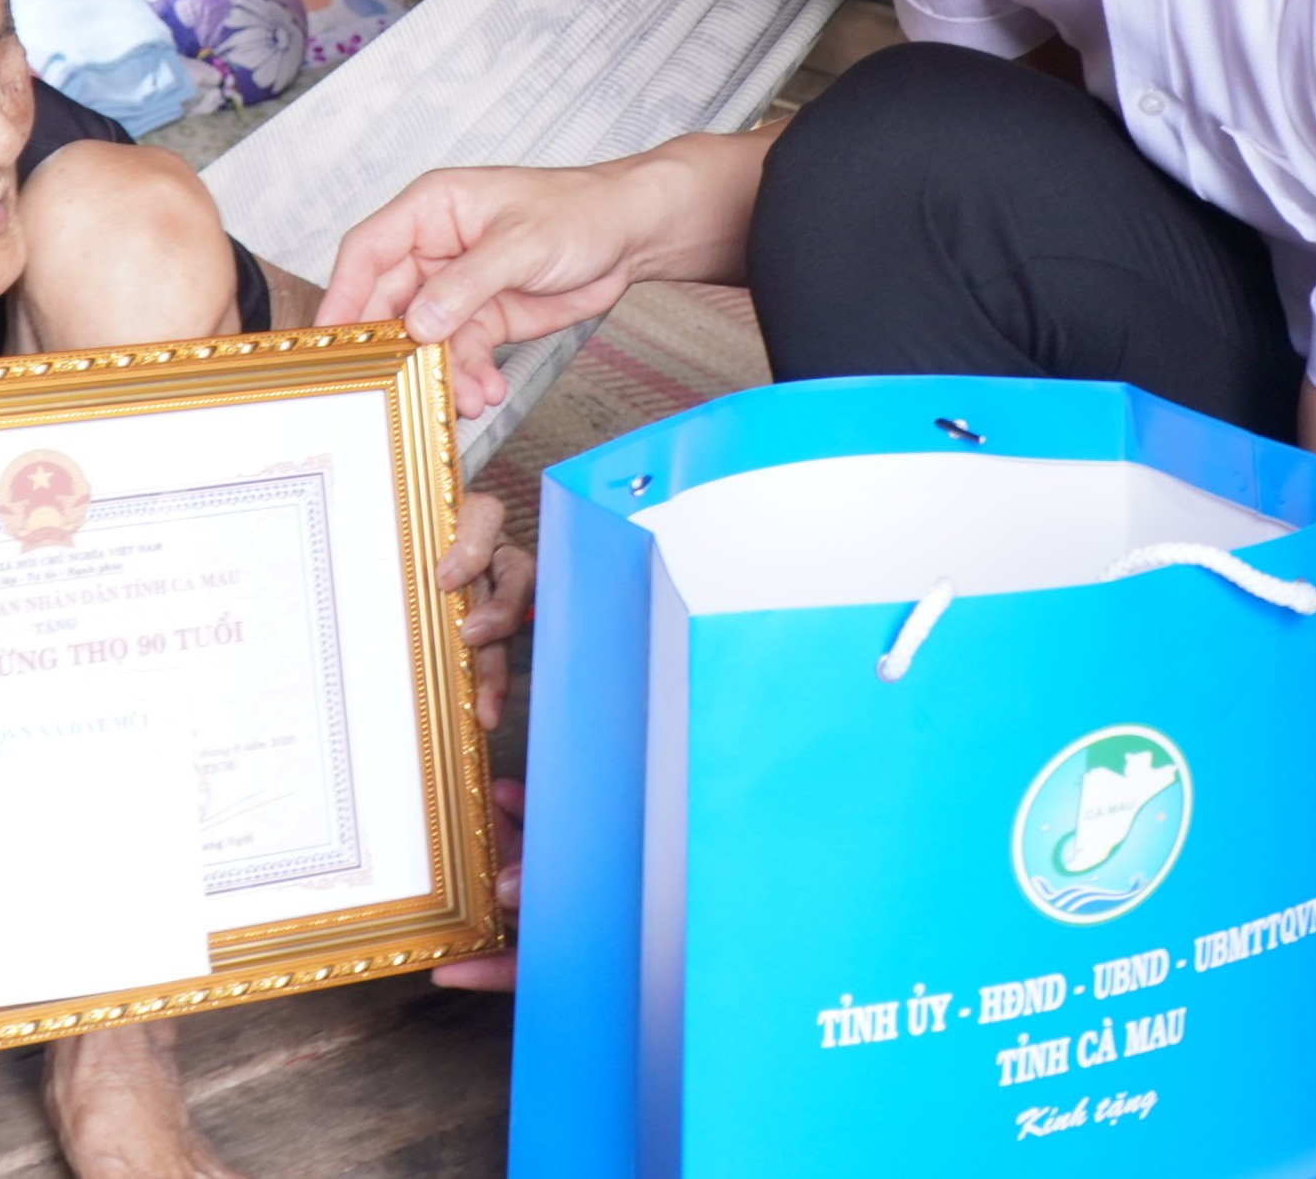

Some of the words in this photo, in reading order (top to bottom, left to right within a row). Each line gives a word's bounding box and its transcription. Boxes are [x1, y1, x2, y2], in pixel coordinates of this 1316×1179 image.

[24, 589, 78, 613] NHÂN
[81, 582, 119, 606] DÂN
[123, 574, 167, 600] TỈNH
[171, 571, 196, 593] CÀ
[199, 568, 241, 589] MAU
[33, 616, 78, 636] TẶNG
[66, 637, 129, 667] THỌ
[136, 632, 166, 658] 90
[174, 611, 246, 652] TUỔI
[1085, 804, 1104, 820] CÀ
[1107, 800, 1136, 815] MAU
[817, 993, 899, 1049] TỈNH
[907, 982, 953, 1037] ỦY
[977, 973, 1067, 1025] HĐND
[1093, 947, 1170, 1001] UBND
[996, 1032, 1069, 1088] TỈNH
[1076, 1018, 1118, 1069] CÀ
[1123, 1007, 1188, 1057] MAU
[1016, 1096, 1088, 1141] Kính
[1093, 1088, 1159, 1127] tặng
